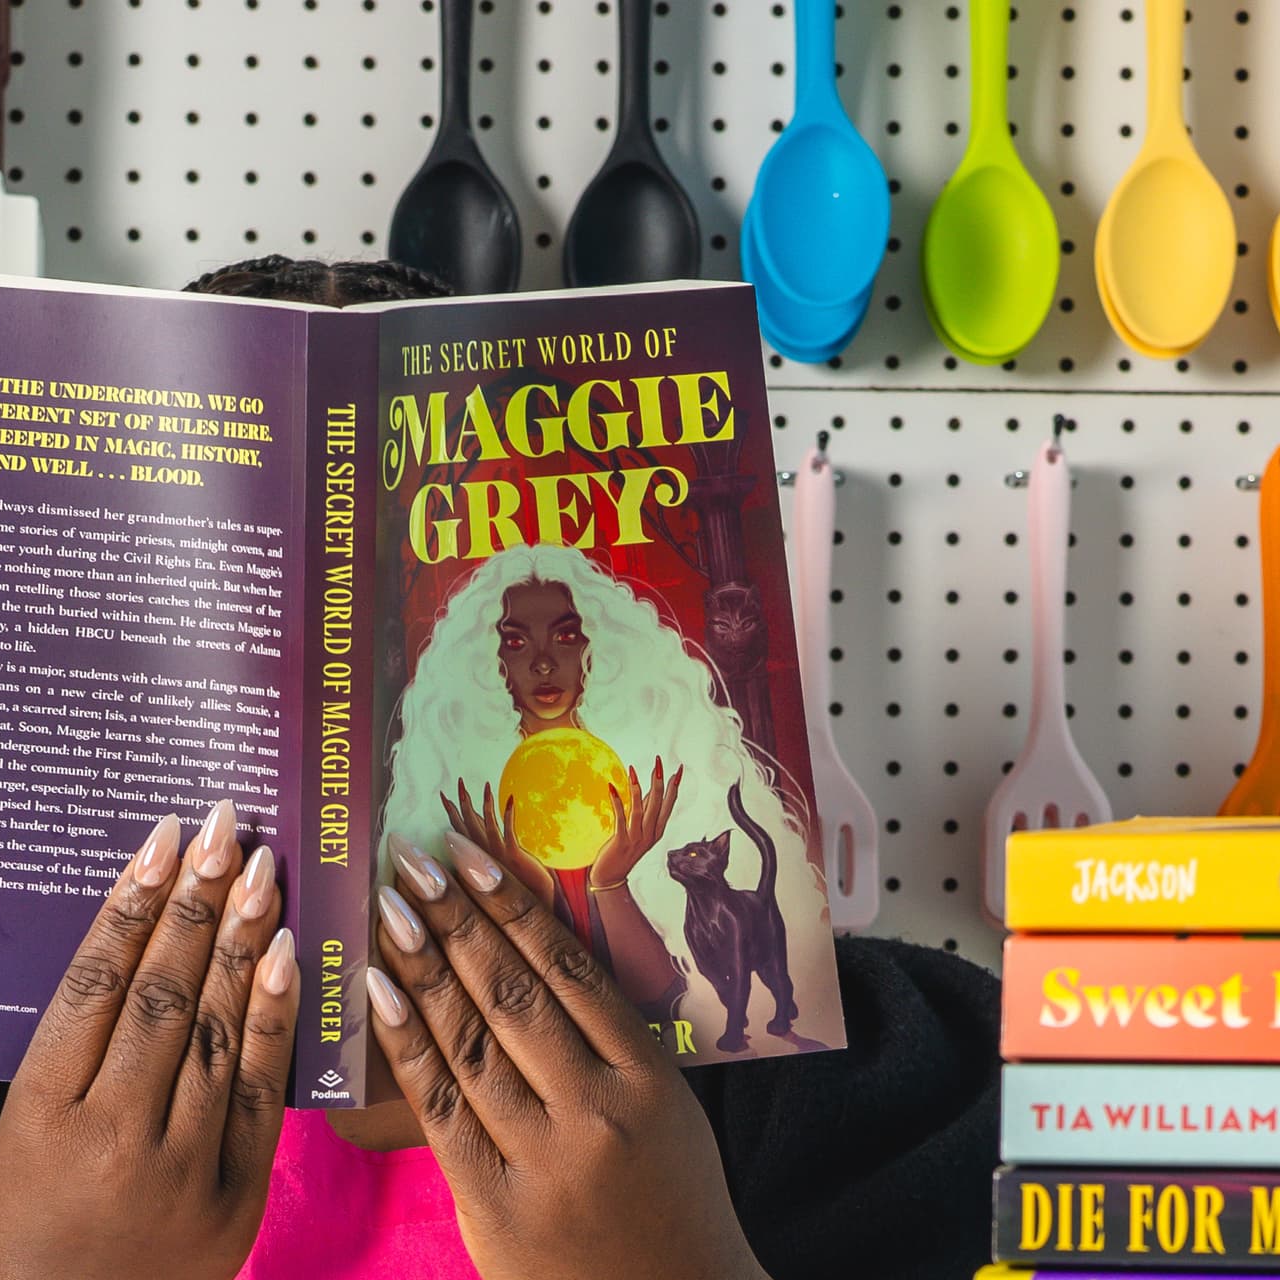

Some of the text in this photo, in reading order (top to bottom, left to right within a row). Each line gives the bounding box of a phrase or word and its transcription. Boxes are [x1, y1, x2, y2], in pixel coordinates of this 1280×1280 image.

[402, 328, 678, 377] THE SECRET WORLD OF
[0, 376, 44, 396] THE
[49, 380, 203, 411] UNDERGROUND.
[208, 394, 236, 413] WE
[239, 396, 264, 415] GO
[79, 407, 120, 427] SET
[125, 410, 153, 431] OF
[157, 414, 219, 437] RULES
[223, 419, 272, 442] HERE.
[382, 371, 735, 491] MAGGIE
[75, 434, 97, 452] IN
[104, 437, 175, 459] MAGIC,
[182, 442, 263, 469] HISTORY,
[32, 457, 93, 477] WELL
[131, 465, 203, 487] BLOOD.
[38, 503, 99, 519] dismissed
[104, 508, 124, 521] her
[217, 519, 241, 531] tales
[244, 524, 254, 532] as
[257, 525, 282, 537] super-
[408, 467, 689, 565] GREY
[20, 525, 58, 537] stories
[63, 526, 76, 537] of
[80, 529, 130, 544] vampiric
[135, 534, 175, 547] priests,
[180, 538, 227, 553] midnight
[232, 543, 264, 557] covens,
[267, 547, 282, 558] and
[319, 404, 356, 868] THE SECRET WORLD OF MAGGIE GREY
[7, 662, 16, 672] is
[19, 665, 26, 673] a
[30, 666, 66, 678] major,
[69, 668, 118, 682] students
[121, 672, 148, 685] with
[151, 675, 182, 687] claws
[185, 678, 206, 690] and
[210, 680, 238, 695] fangs
[240, 686, 264, 696] roam
[267, 687, 280, 698] the
[10, 819, 49, 832] harder
[53, 824, 64, 832] to
[68, 824, 108, 837] ignore.
[1072, 859, 1198, 905] JACKSON
[321, 940, 342, 1045] GRANGER
[1040, 967, 1251, 1028] Sweet
[311, 1090, 349, 1100] Podium
[1030, 1104, 1094, 1130] TIA
[1020, 1183, 1104, 1250] DIE
[1127, 1184, 1225, 1253] FOR
